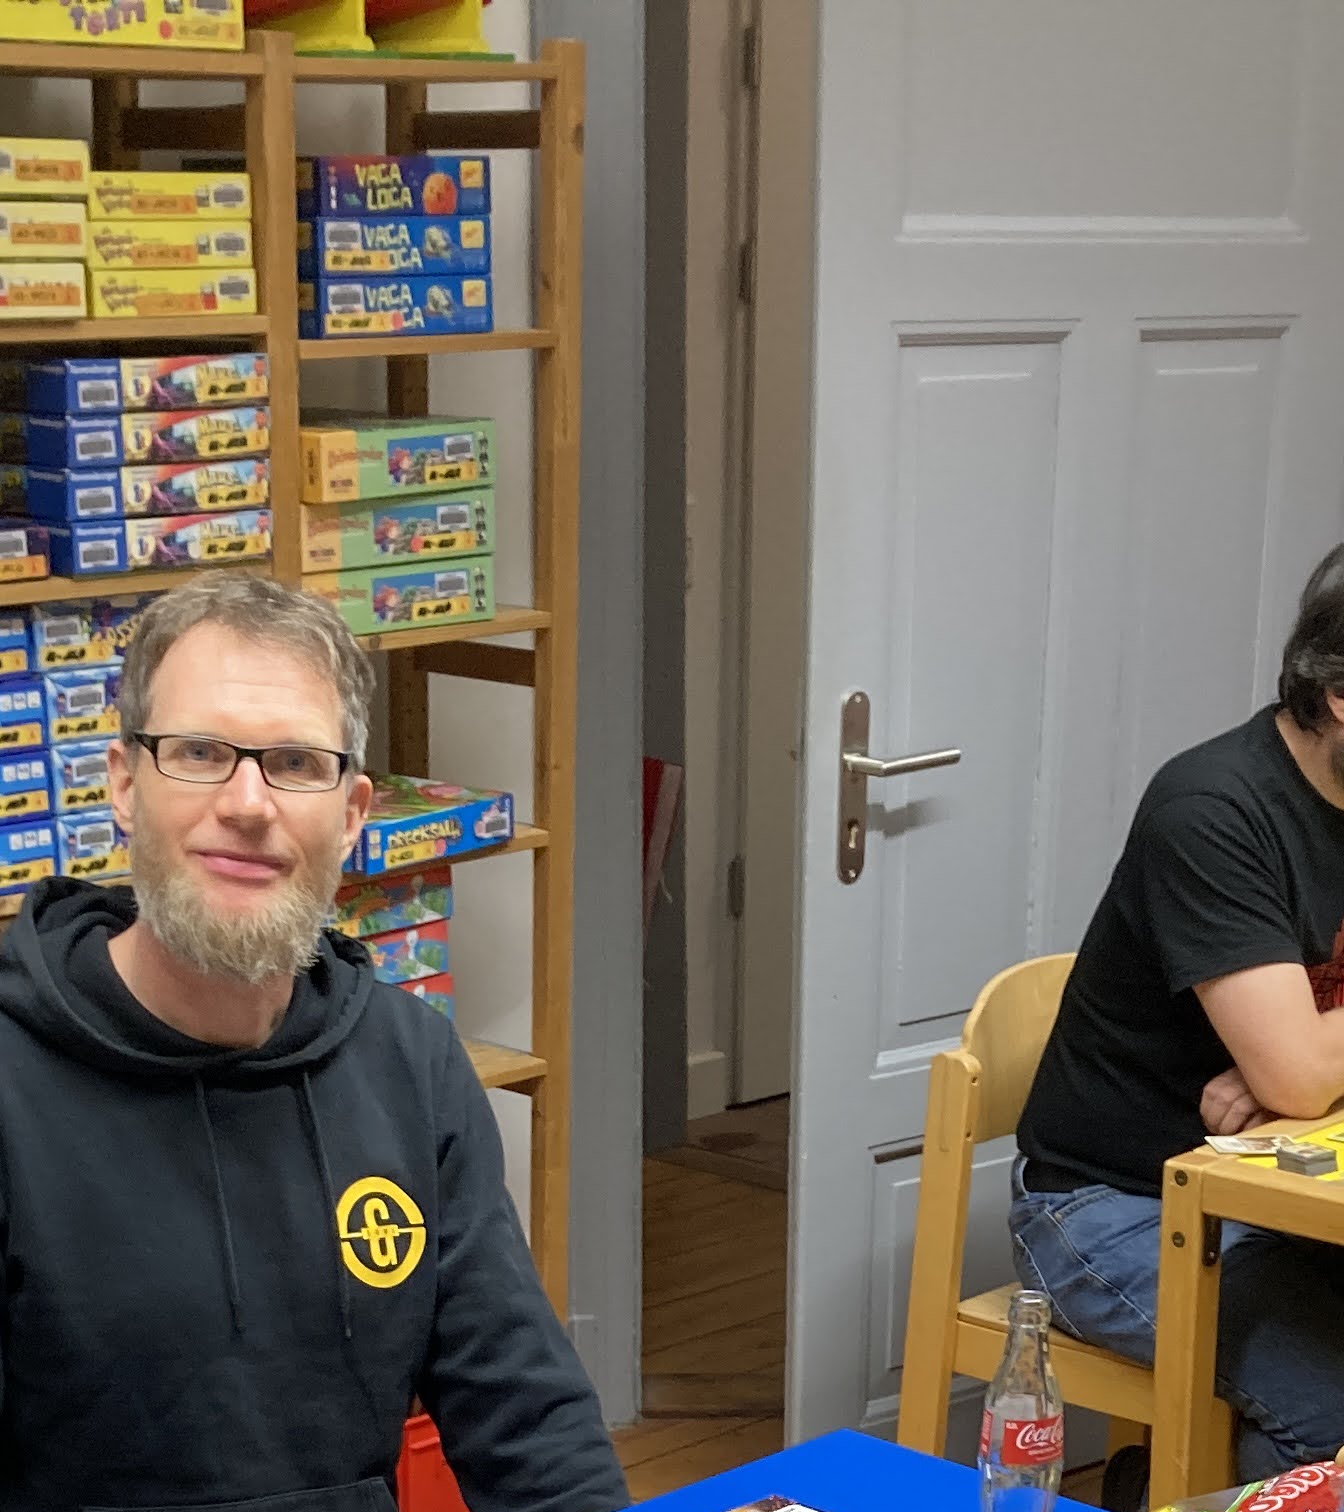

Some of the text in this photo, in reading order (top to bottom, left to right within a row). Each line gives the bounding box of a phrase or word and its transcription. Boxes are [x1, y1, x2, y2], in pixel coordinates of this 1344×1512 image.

[355, 163, 404, 188] VACA
[366, 187, 414, 211] LOCA
[363, 223, 412, 248] VACA
[365, 284, 414, 308] VACA
